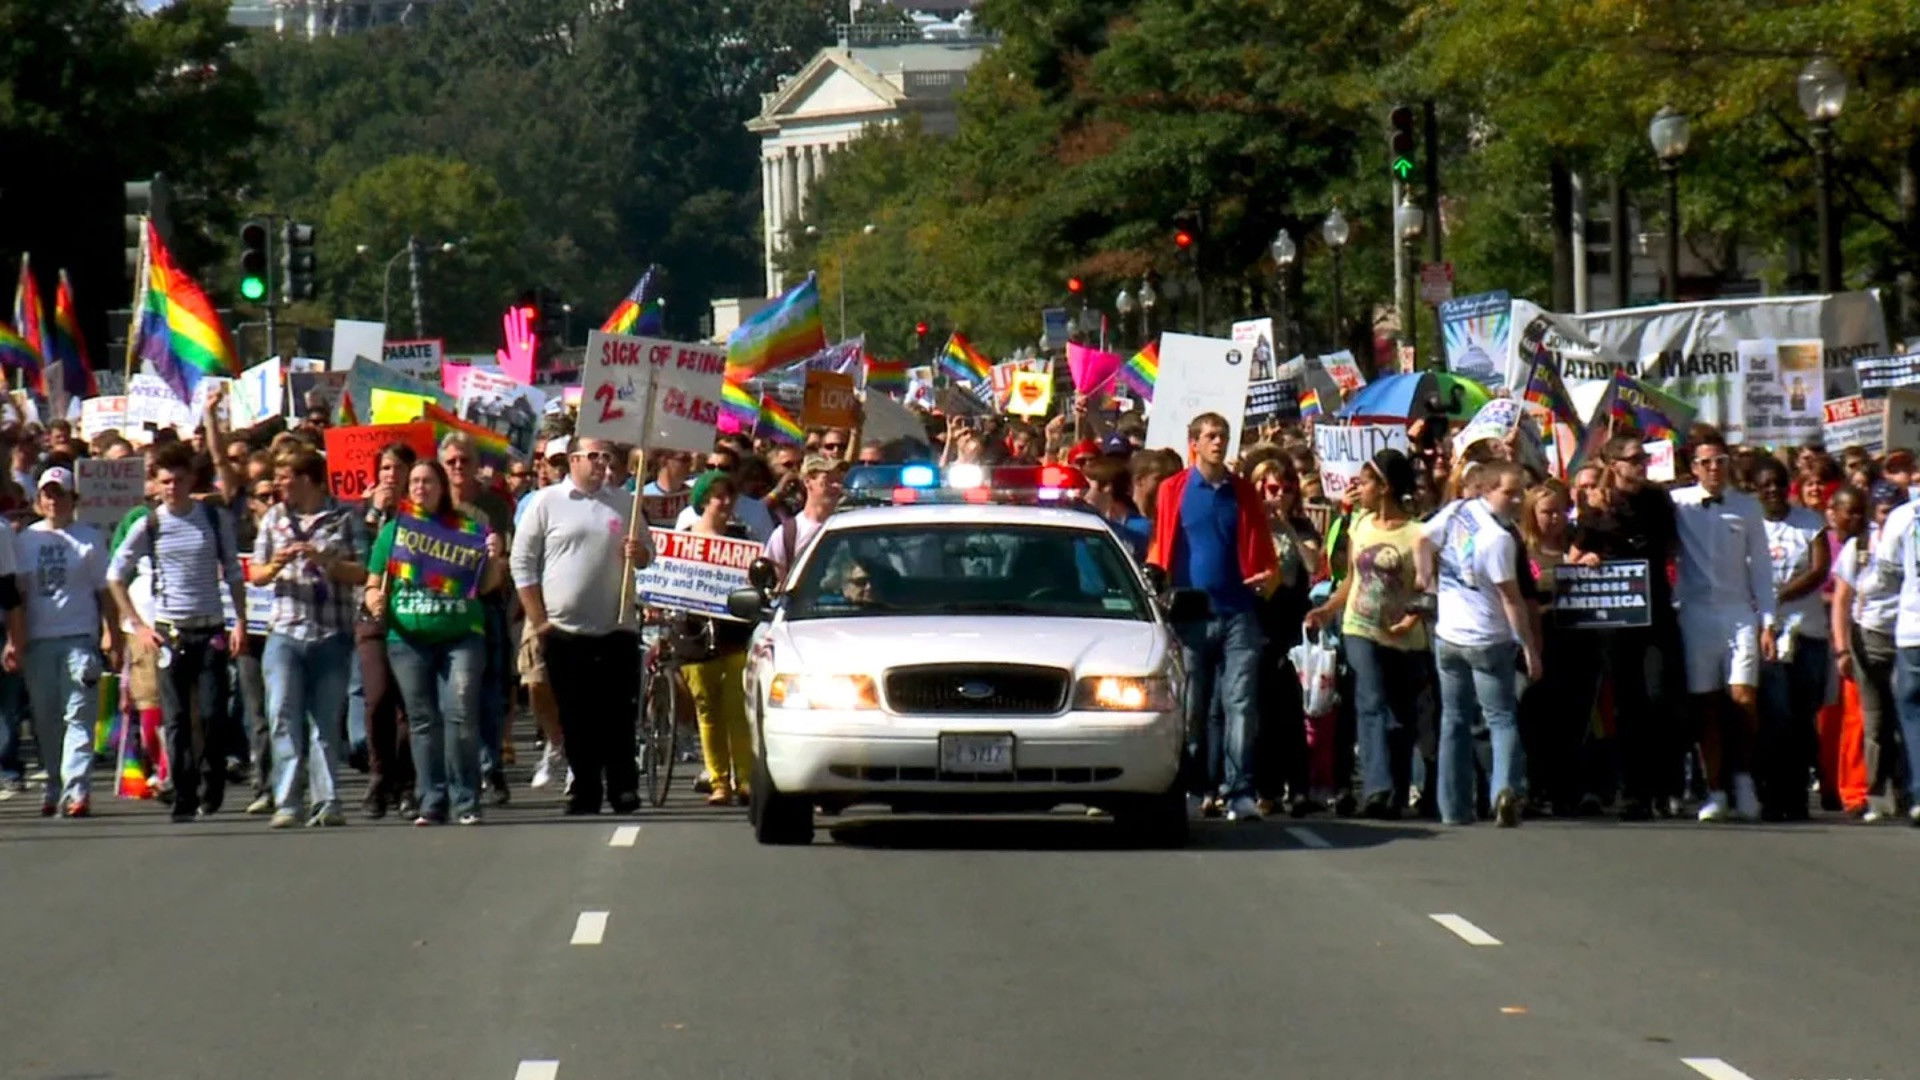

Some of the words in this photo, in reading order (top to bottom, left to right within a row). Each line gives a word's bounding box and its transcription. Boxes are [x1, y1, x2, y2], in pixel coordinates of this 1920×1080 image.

[601, 340, 641, 366] SICK
[649, 345, 673, 367] OF
[1658, 350, 1739, 377] MARRI
[395, 526, 481, 569] EQUALITY
[671, 536, 705, 560] THE
[708, 540, 758, 569] HARM
[1557, 564, 1646, 580] EQUALITY
[672, 577, 693, 590] and
[1570, 582, 1630, 592] ACROSS
[1557, 594, 1646, 609] AMERICA
